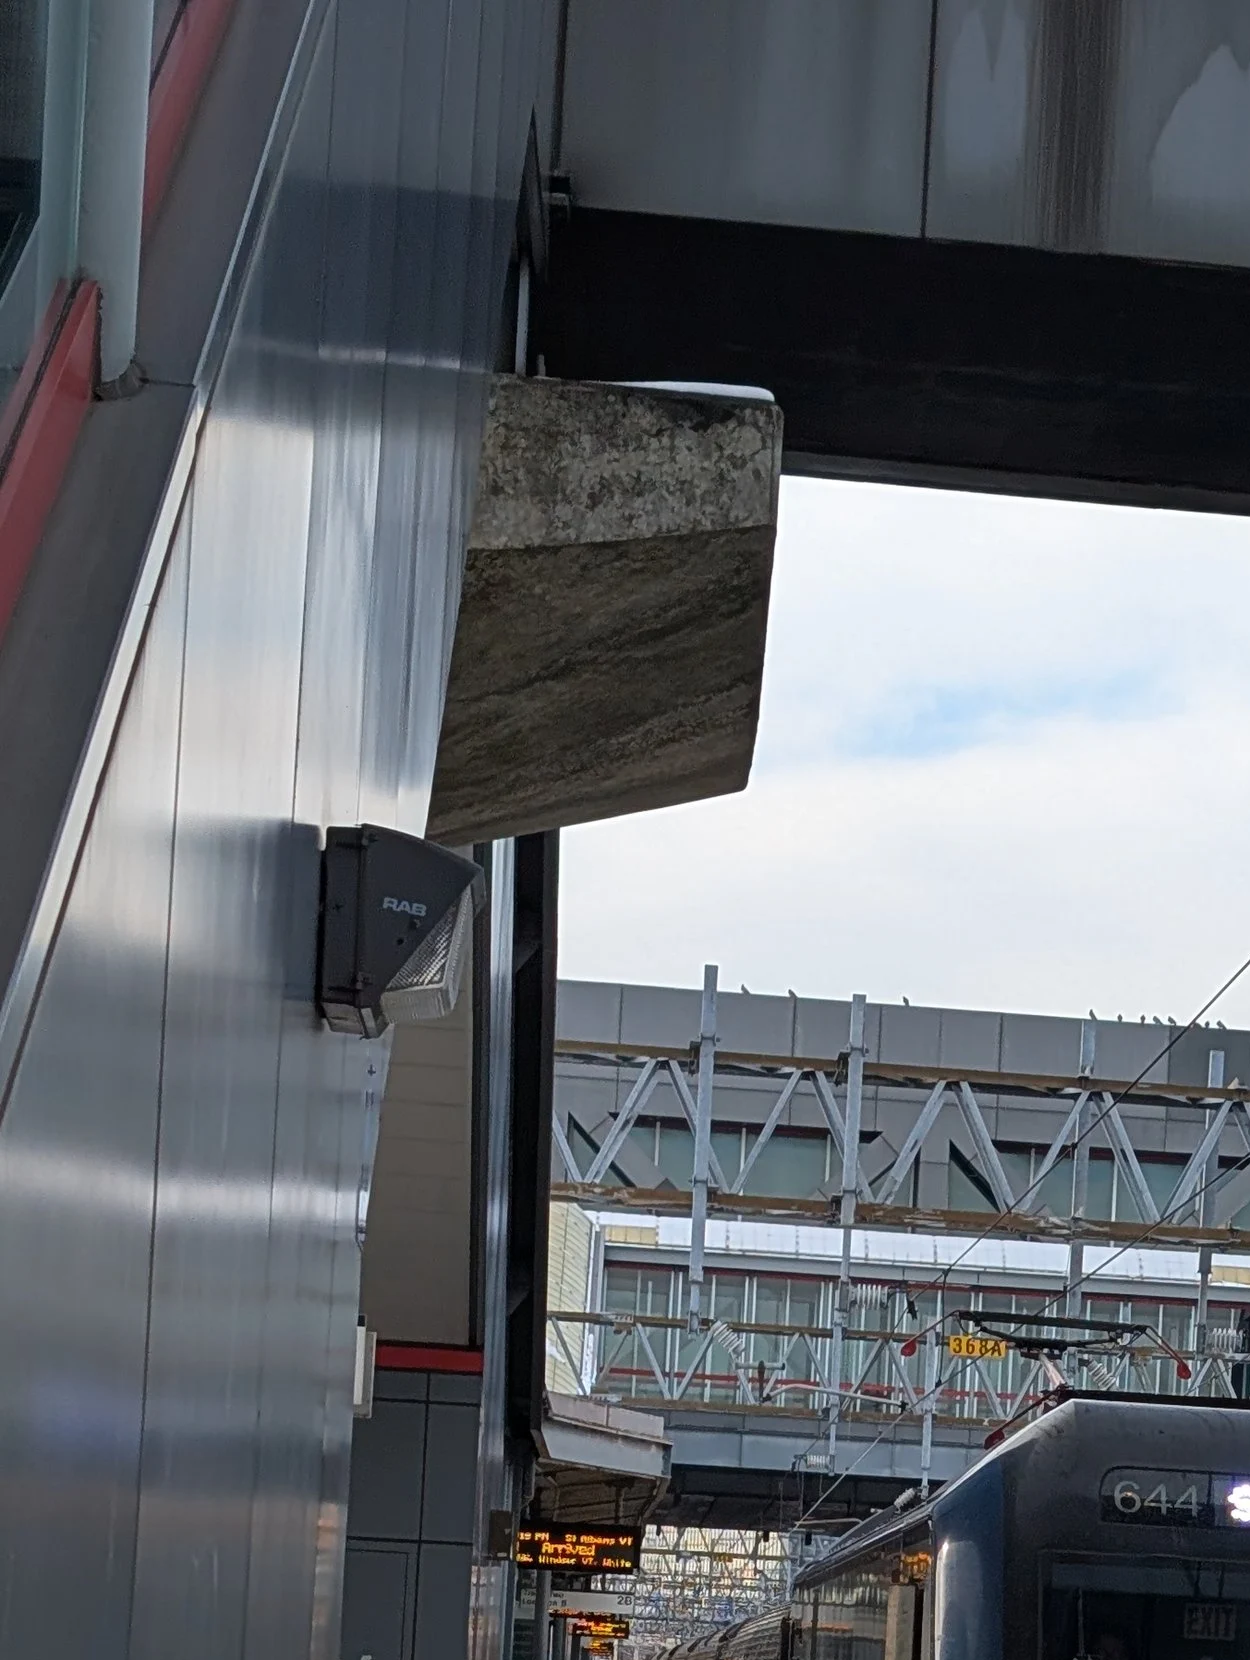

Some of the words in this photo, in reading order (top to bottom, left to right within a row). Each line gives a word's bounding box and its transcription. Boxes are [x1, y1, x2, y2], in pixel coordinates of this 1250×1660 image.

[382, 896, 427, 917] RAB
[952, 1337, 1002, 1357] 368A
[1113, 1480, 1202, 1517] 644
[535, 1532, 550, 1541] PM
[580, 1534, 615, 1546] Albans
[619, 1536, 633, 1546] VT
[541, 1542, 596, 1557] Arrived
[538, 1554, 577, 1566] Windsor
[602, 1557, 631, 1568] White
[617, 1594, 633, 1606] 2B
[1187, 1606, 1233, 1638] EXIT
